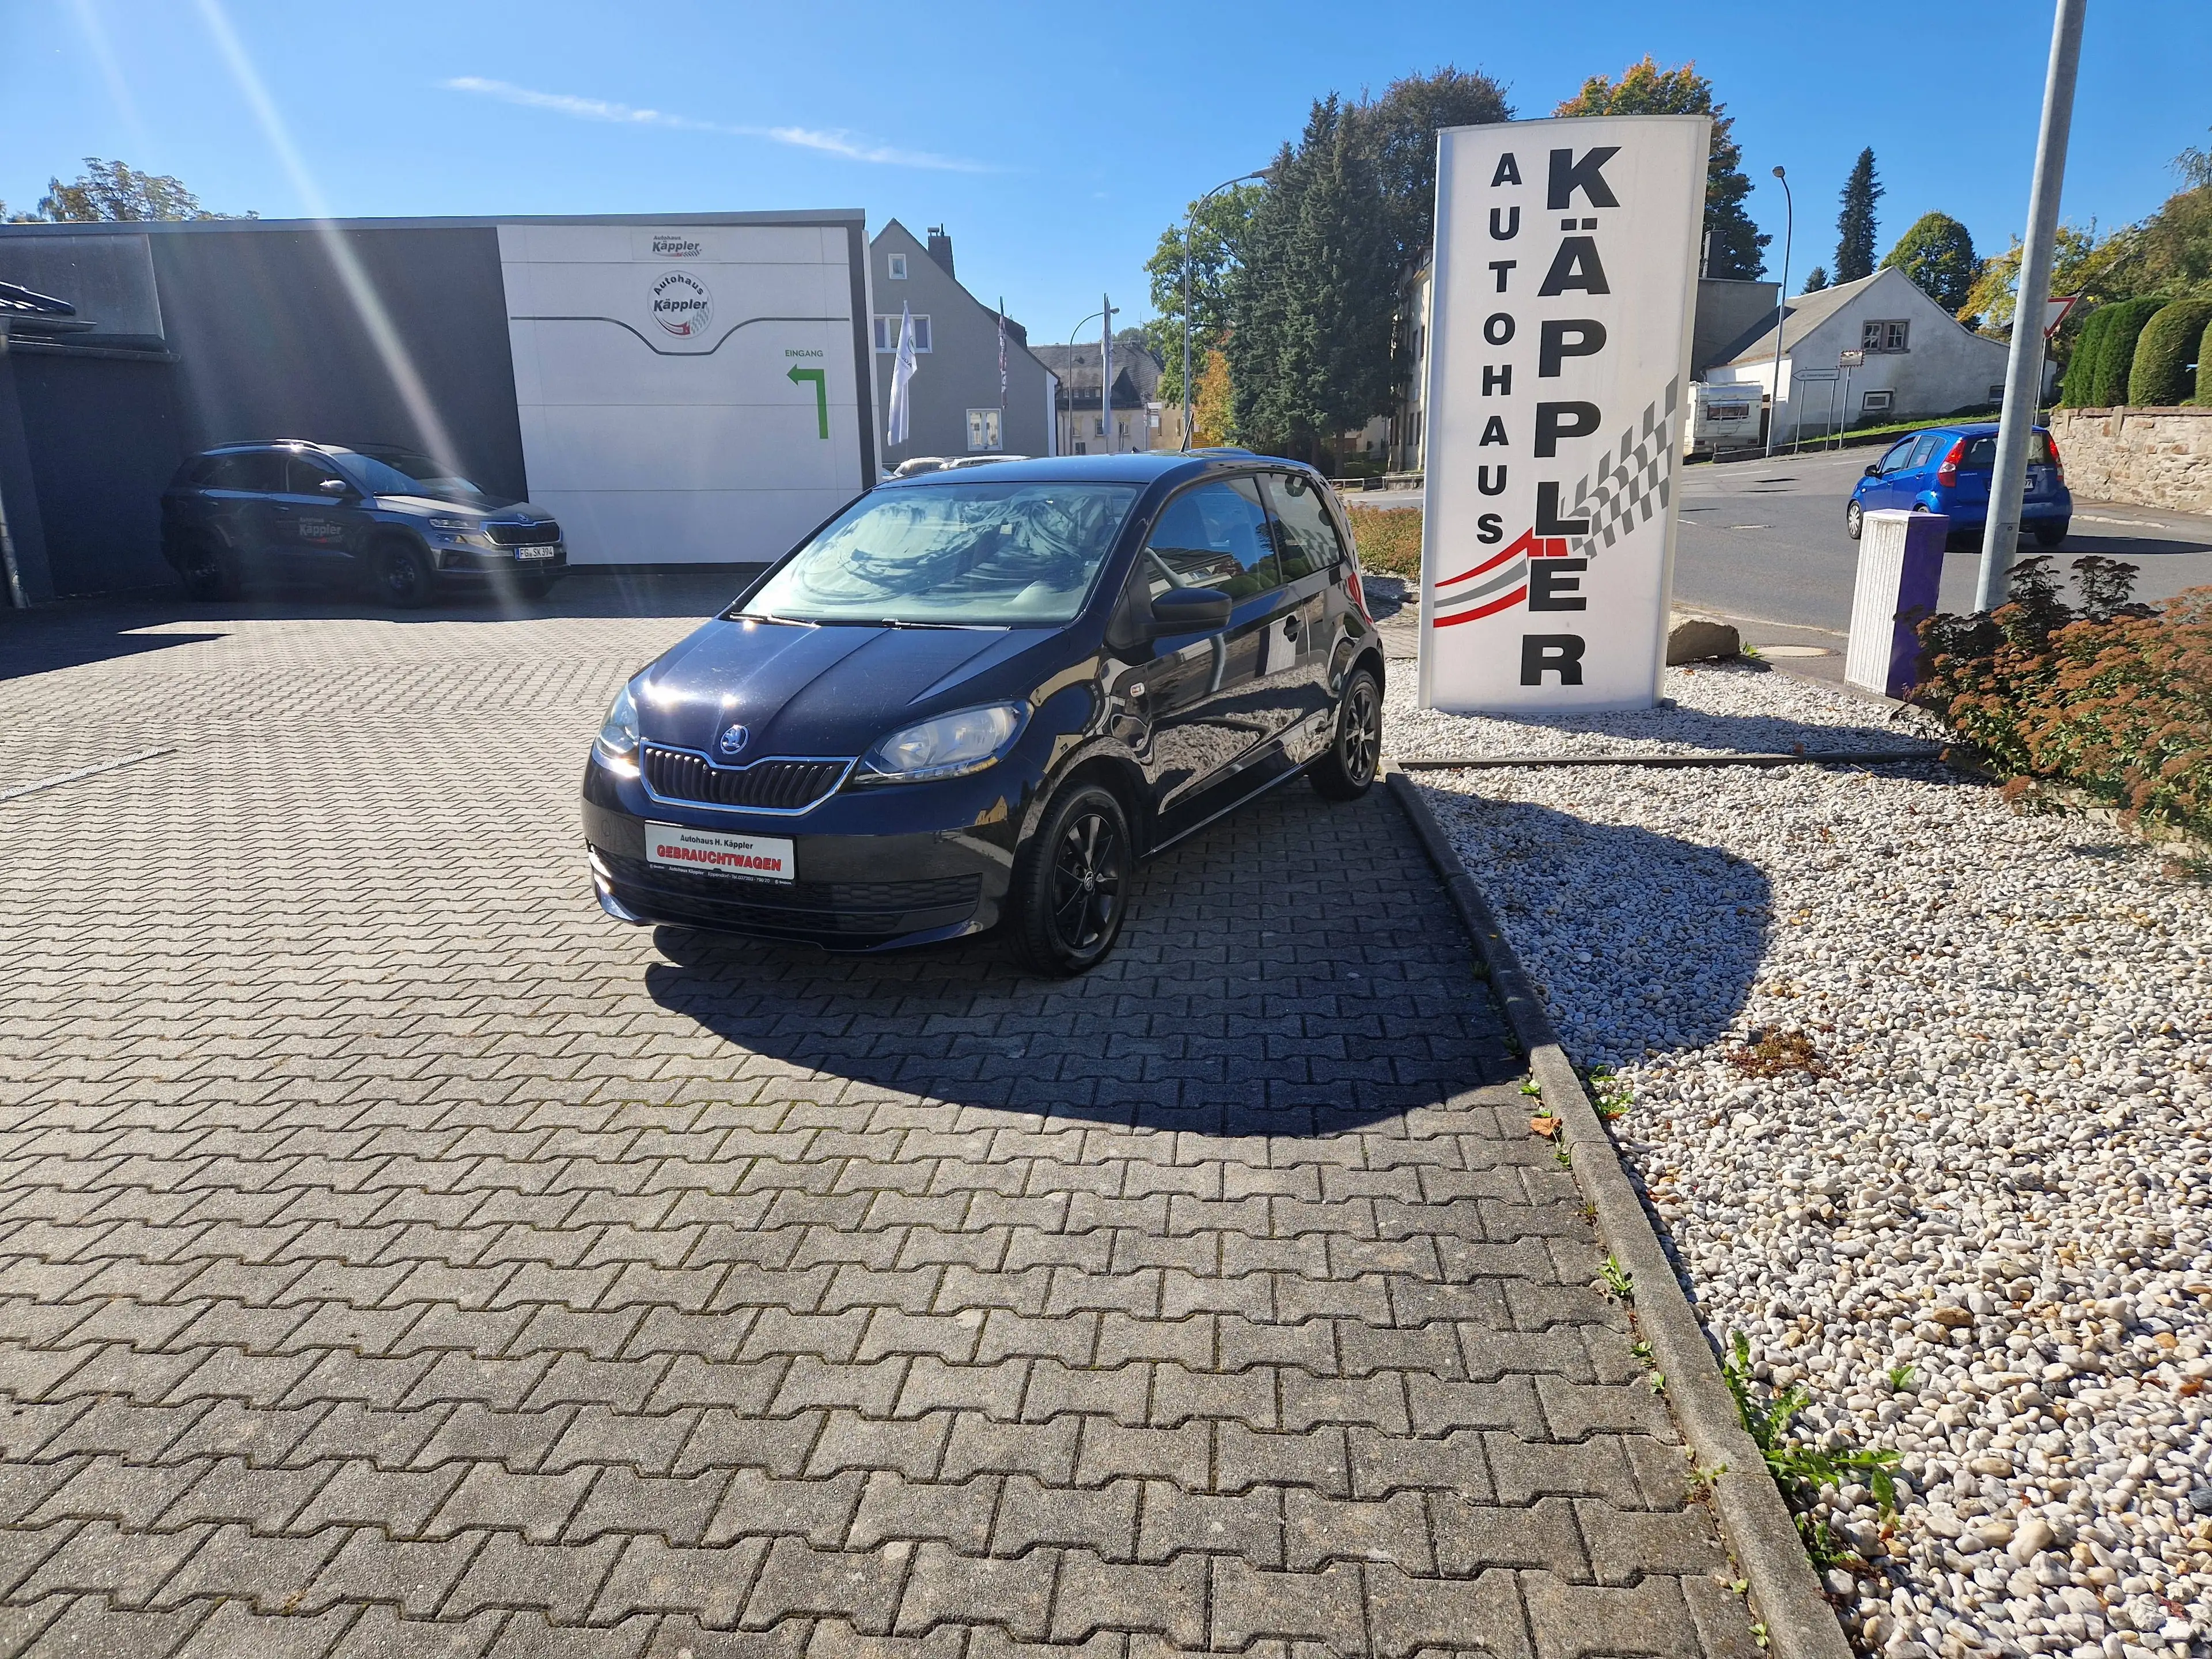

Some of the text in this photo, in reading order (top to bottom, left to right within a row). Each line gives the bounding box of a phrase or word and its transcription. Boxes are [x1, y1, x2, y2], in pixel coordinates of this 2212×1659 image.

[652, 240, 700, 252] Käppler
[653, 274, 704, 296] Autohaus
[653, 298, 707, 312] Käppler
[785, 349, 824, 357] EINGANG
[1477, 153, 1522, 544] AUTOHAUS
[1520, 147, 1622, 685] KÄPPLER
[680, 834, 753, 850] Autohaus H. Käppler
[657, 844, 782, 872] GEBRAUCHTWAGEN
